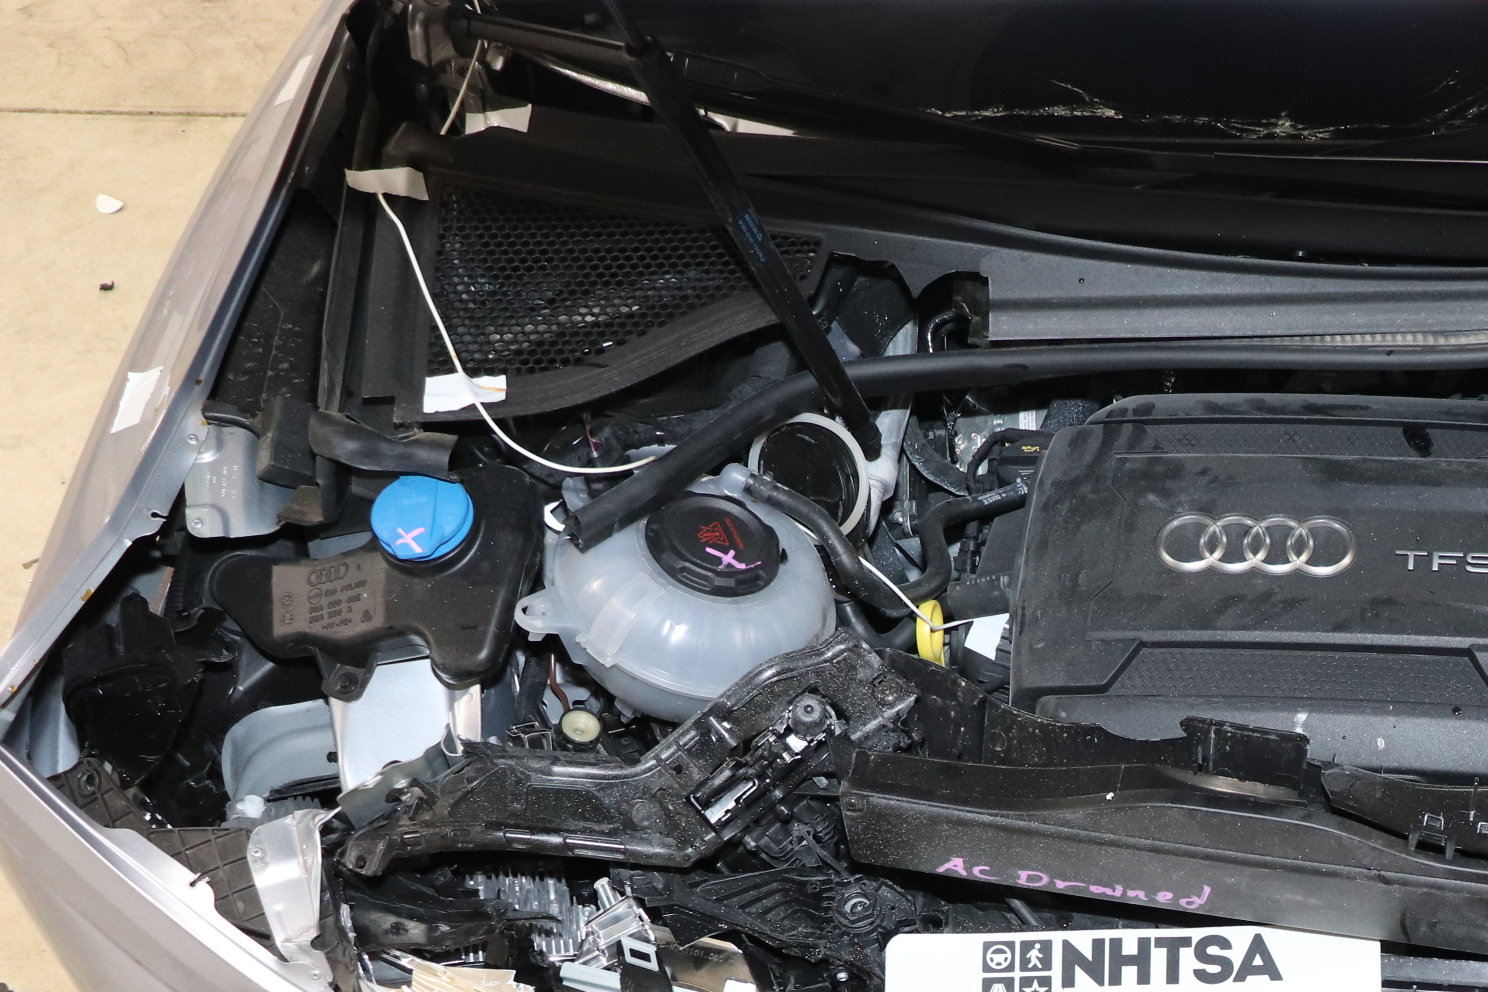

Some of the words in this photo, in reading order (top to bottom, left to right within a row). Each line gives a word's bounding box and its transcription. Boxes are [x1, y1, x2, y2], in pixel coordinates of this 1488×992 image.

[935, 857, 1001, 880] AC
[1016, 869, 1212, 909] Drained
[1062, 934, 1283, 988] NHTSA
